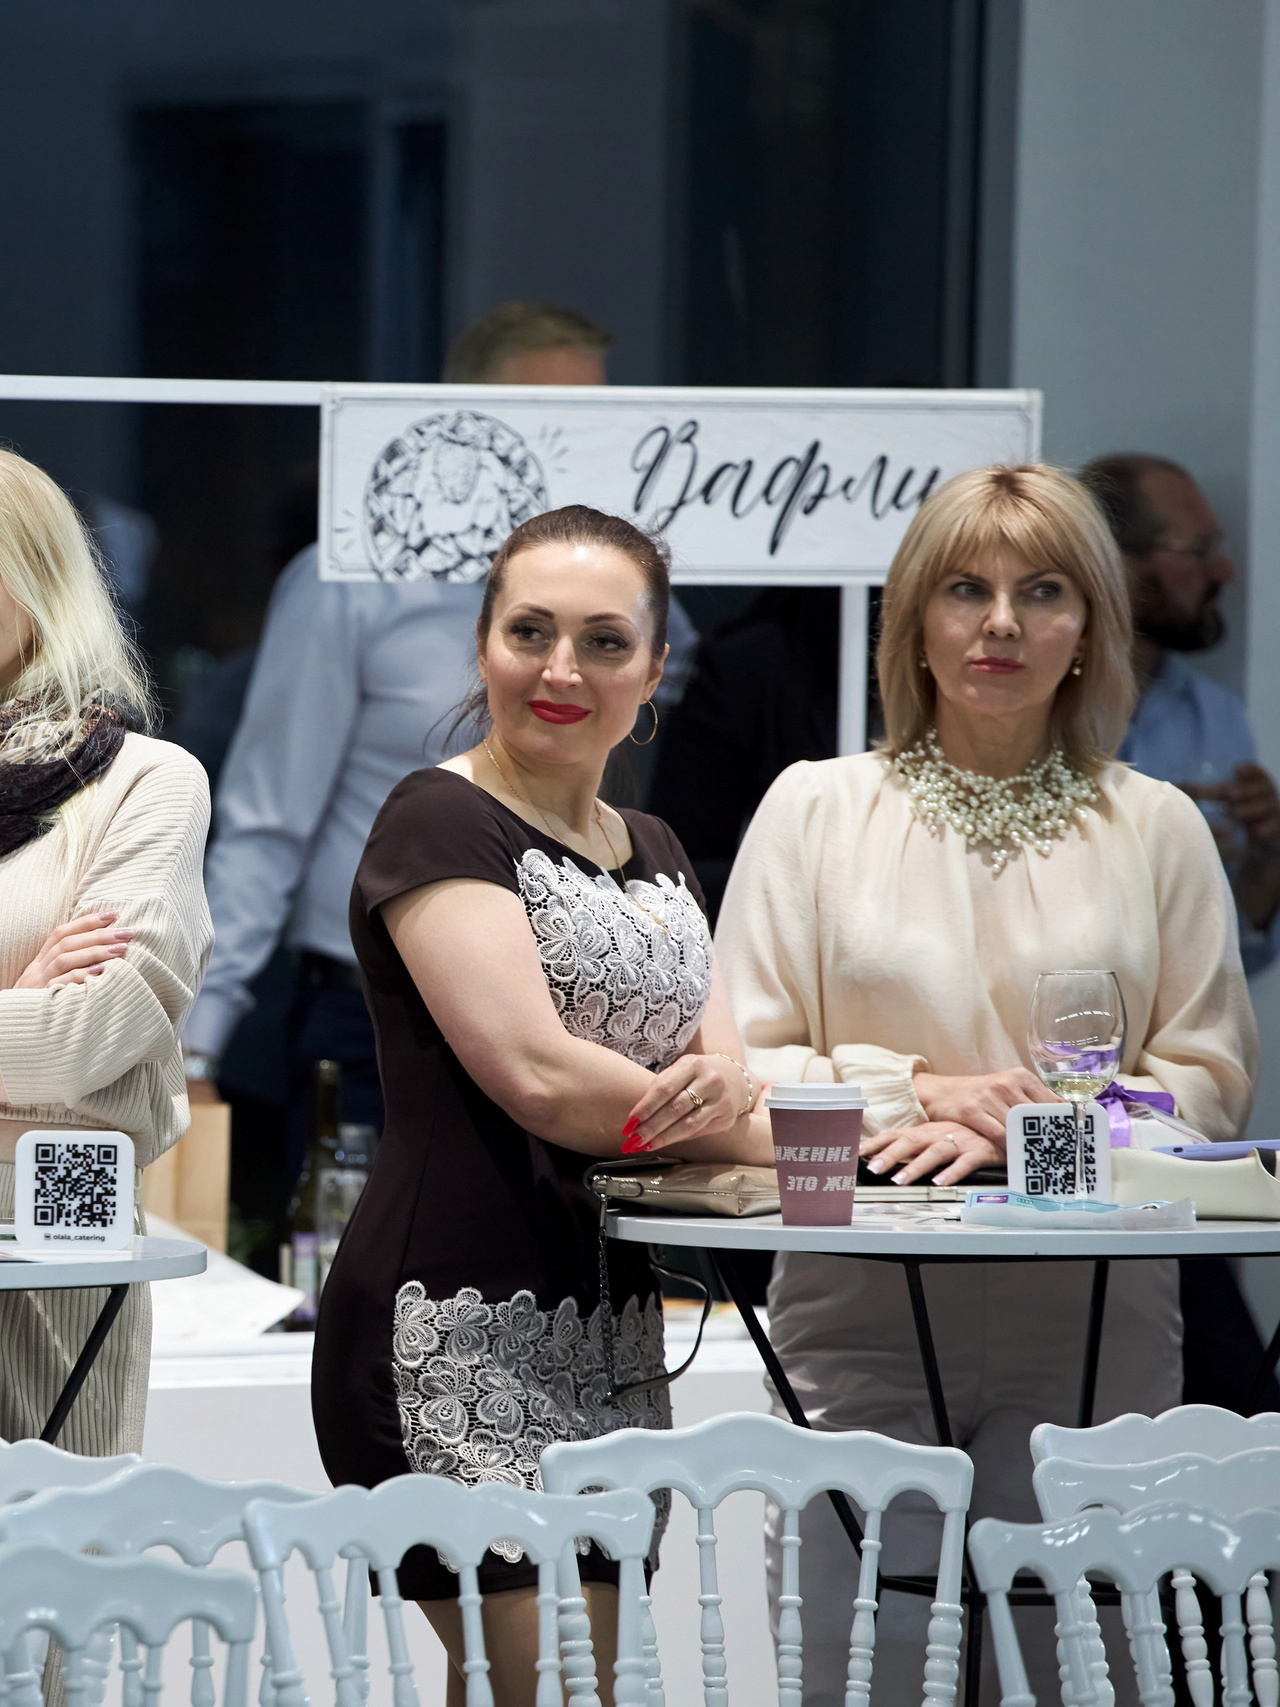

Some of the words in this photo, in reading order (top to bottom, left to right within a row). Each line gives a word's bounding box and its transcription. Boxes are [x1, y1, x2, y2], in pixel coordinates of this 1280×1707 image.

[630, 419, 941, 556] Вафли
[786, 1175, 819, 1192] ЭТО
[53, 1234, 106, 1242] olala_catering
